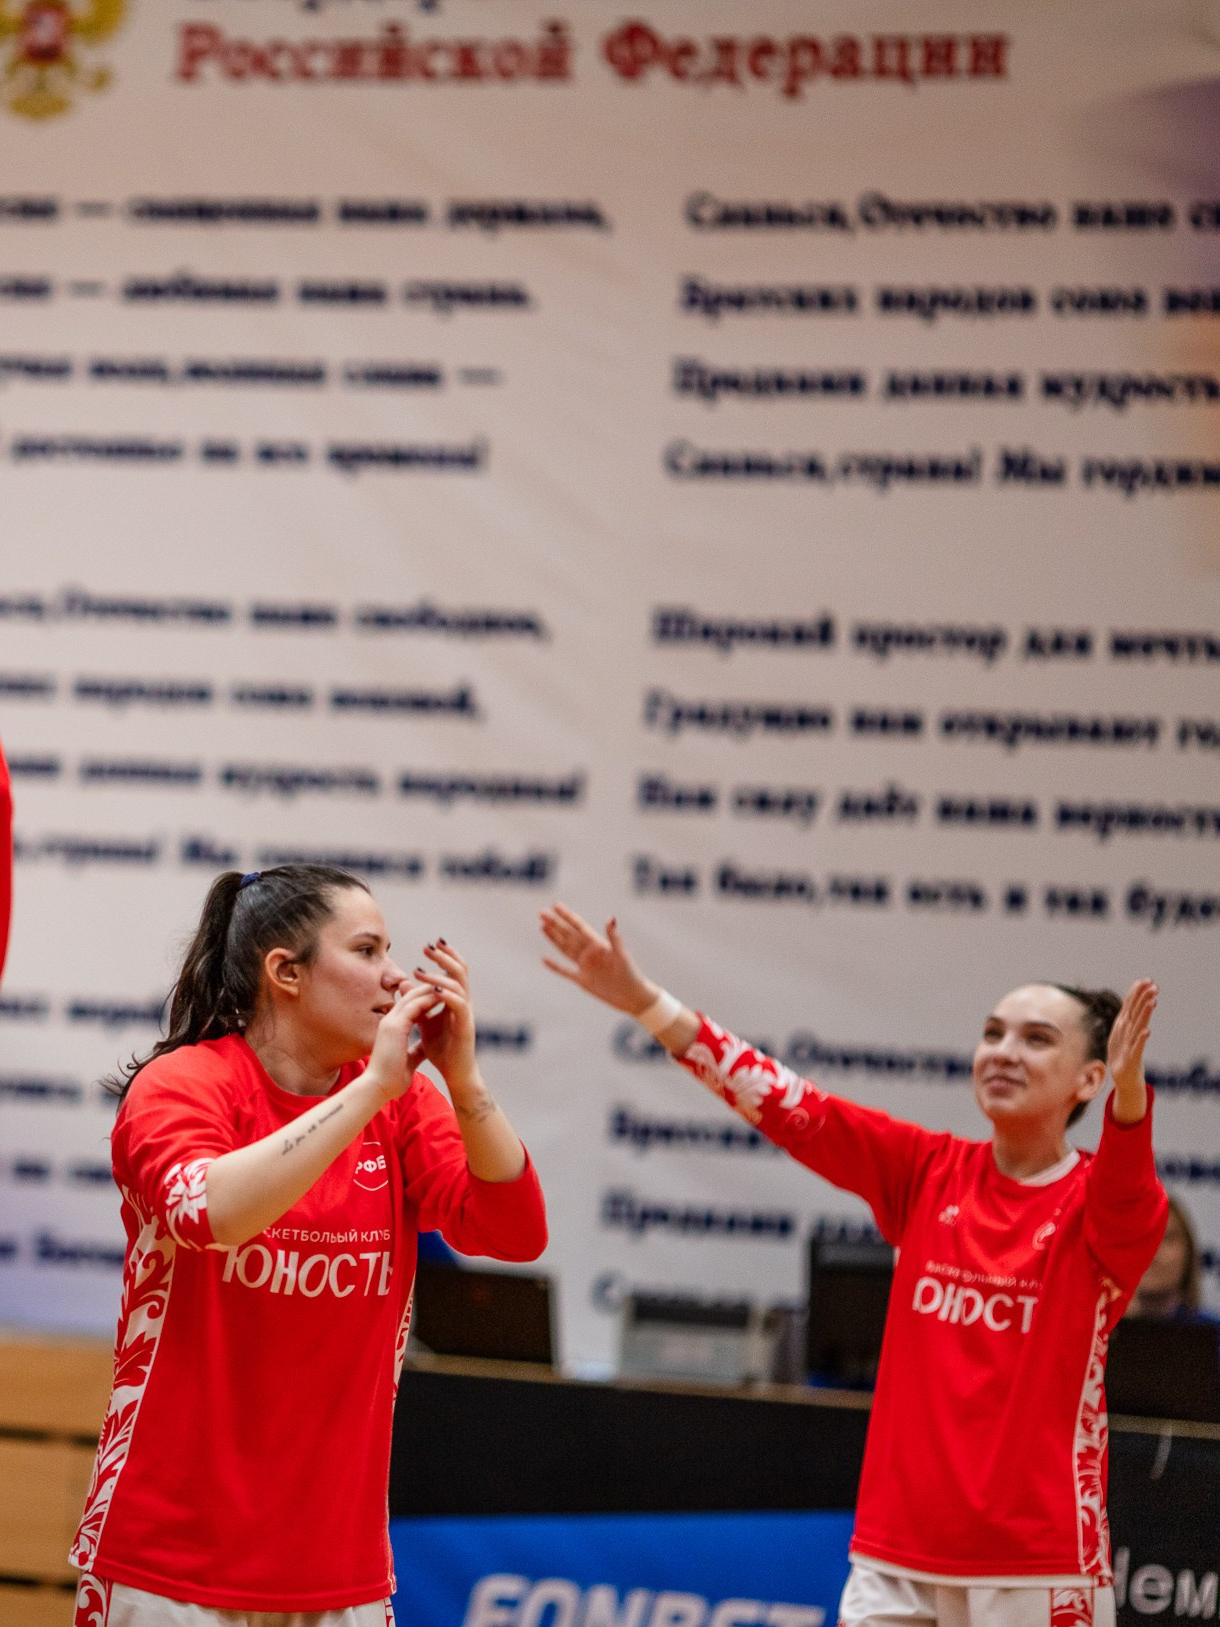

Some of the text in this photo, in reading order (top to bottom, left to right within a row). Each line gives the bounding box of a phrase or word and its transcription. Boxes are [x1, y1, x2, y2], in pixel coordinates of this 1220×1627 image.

[177, 19, 1010, 100] Российской Федерации
[222, 1244, 393, 1298] ЮНОСТЬ
[912, 1276, 1038, 1334] ЮНОСТ
